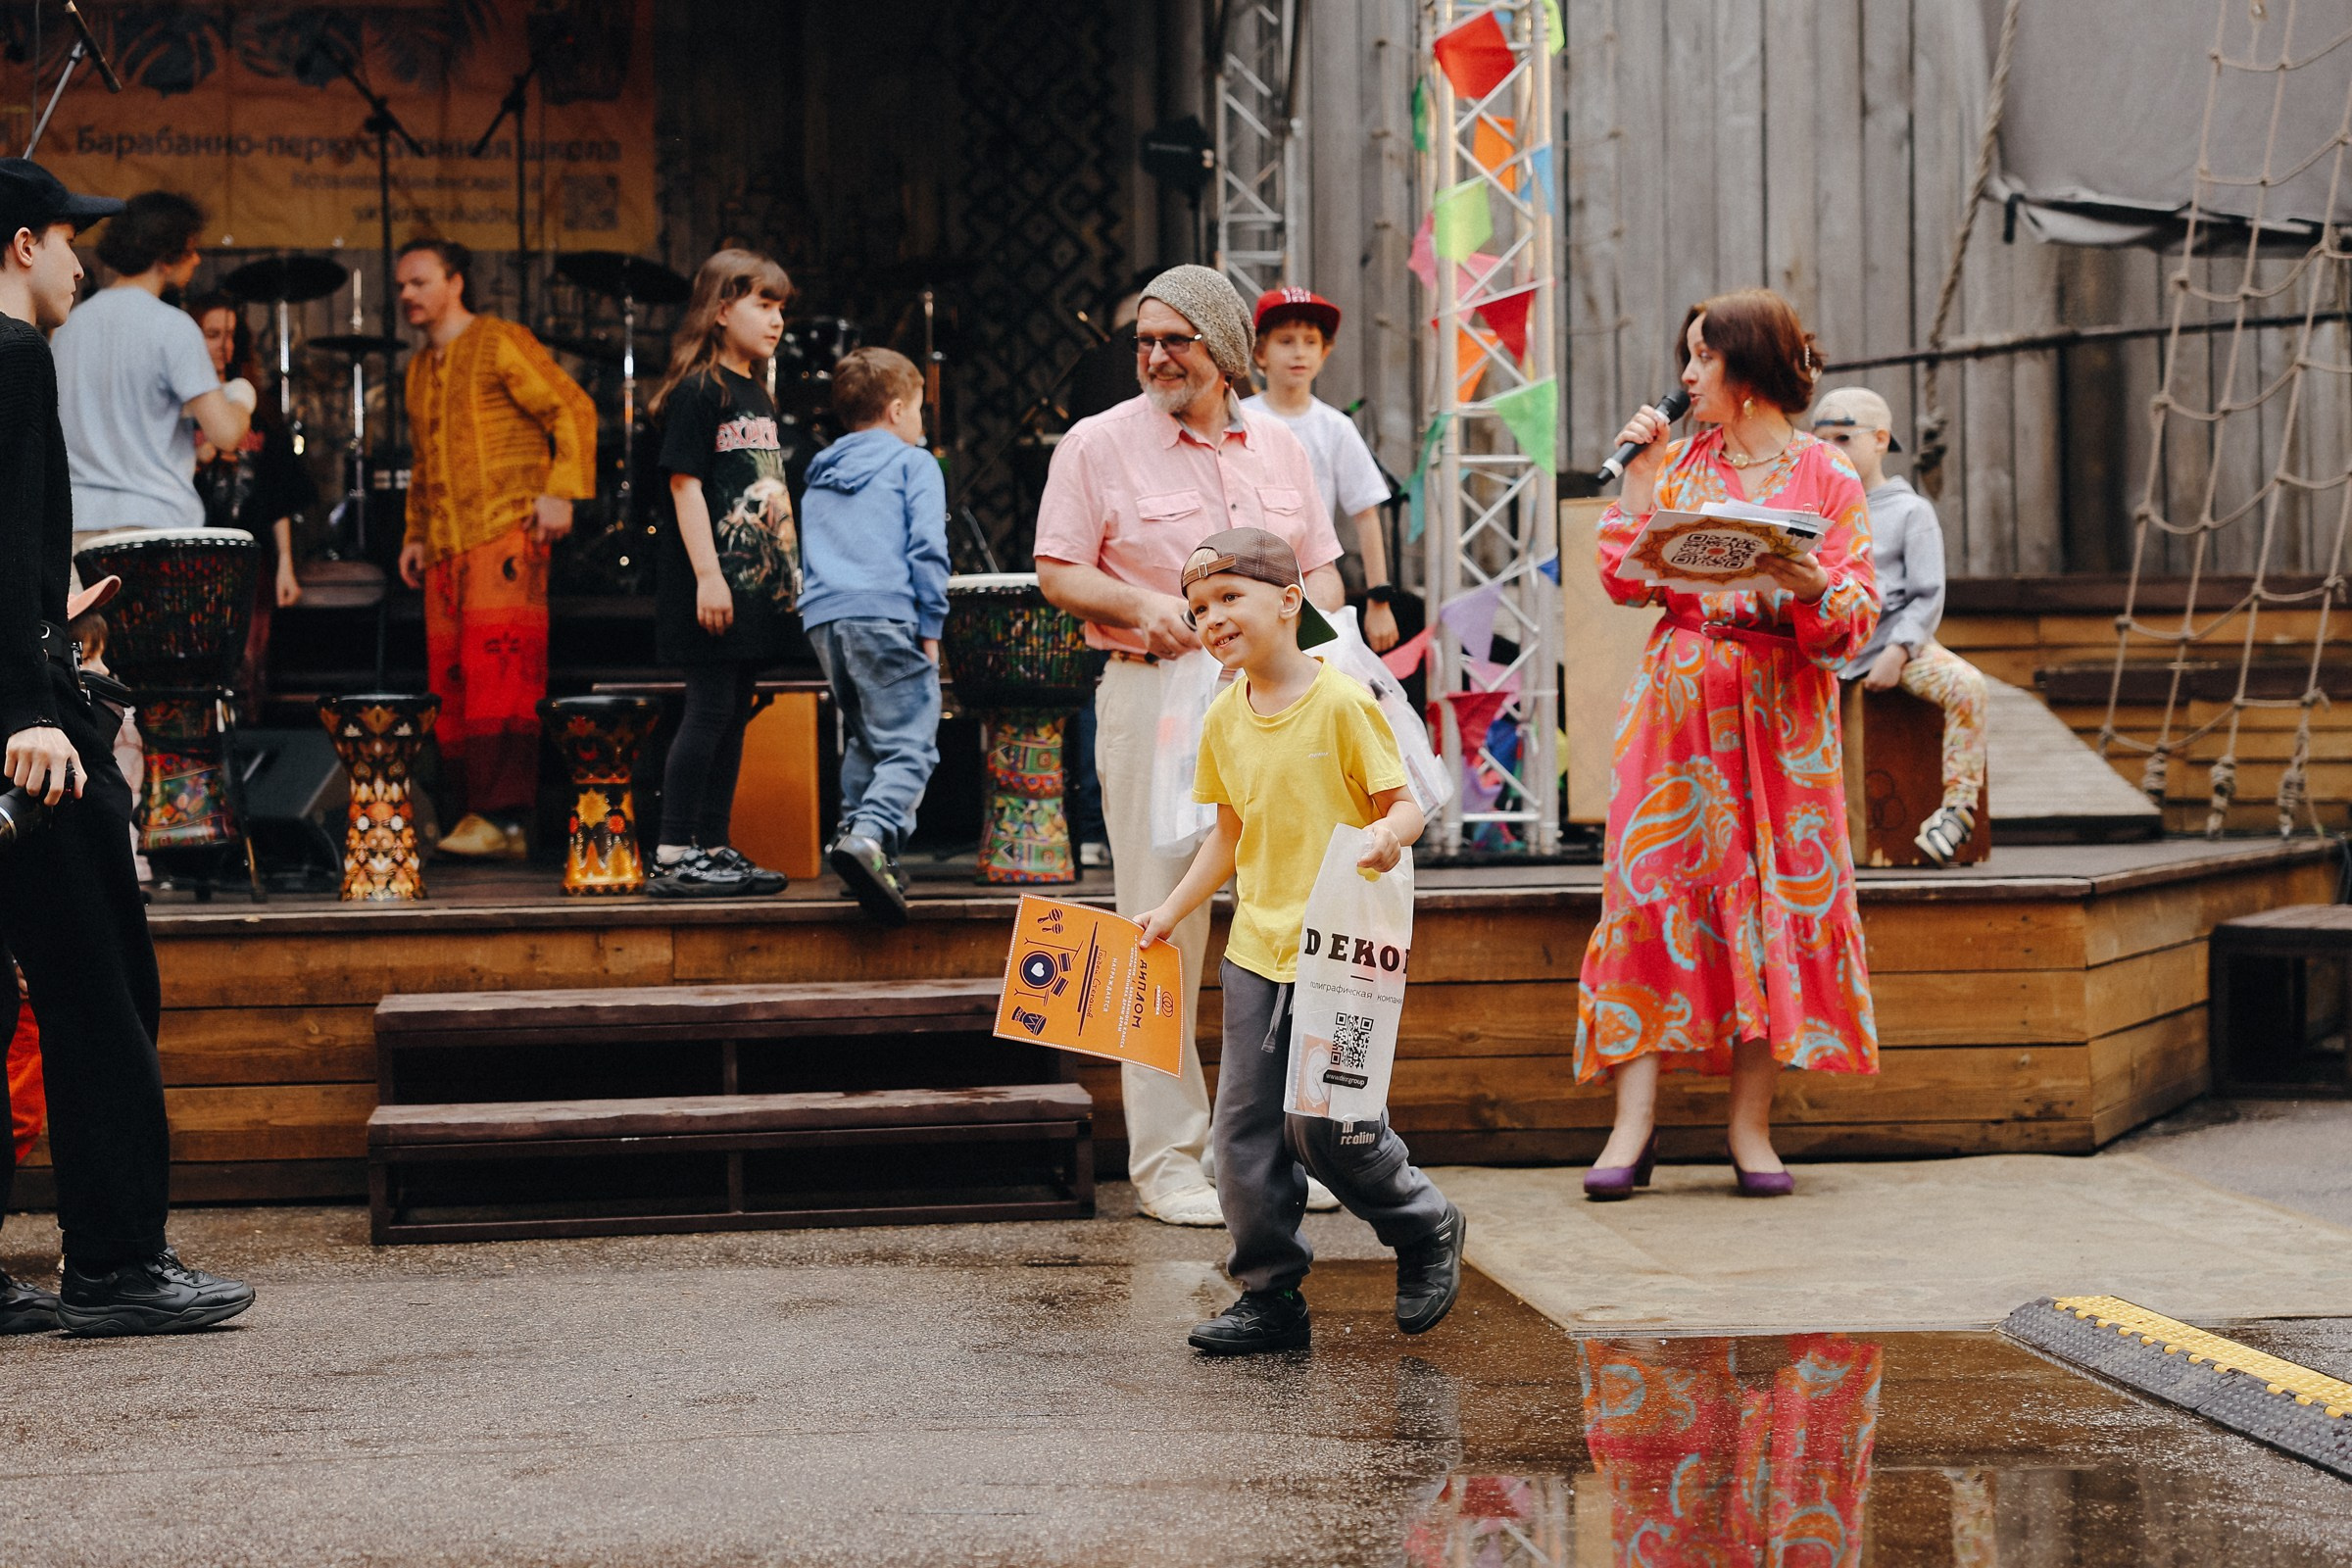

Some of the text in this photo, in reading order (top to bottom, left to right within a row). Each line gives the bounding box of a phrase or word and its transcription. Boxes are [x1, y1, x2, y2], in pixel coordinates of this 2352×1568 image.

[1087, 978, 1102, 1018] Степанов
[1102, 957, 1117, 1012] НАГРАЖДАЕТСЯ
[1132, 959, 1148, 1028] ДИПЛОМ
[1124, 986, 1134, 1025] БАРАБАННОГО
[1119, 1026, 1128, 1049] КЛАССА
[1340, 1131, 1376, 1146] reality
